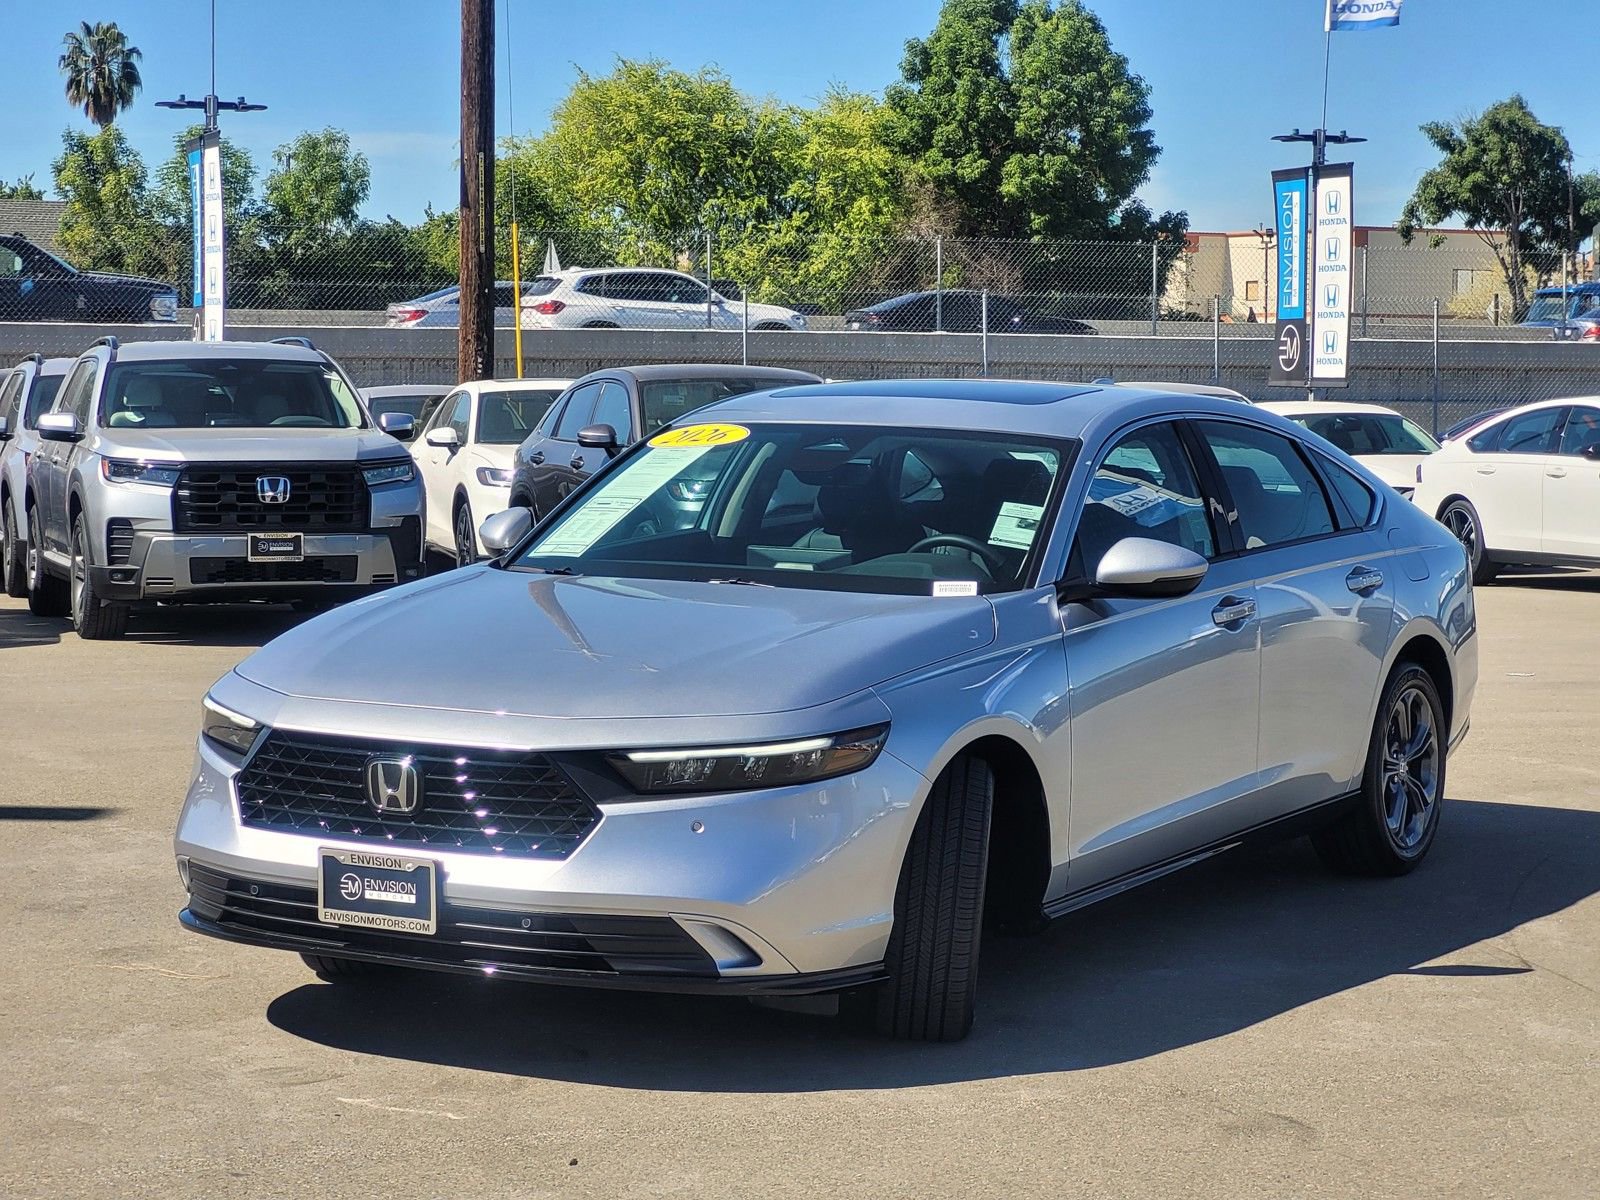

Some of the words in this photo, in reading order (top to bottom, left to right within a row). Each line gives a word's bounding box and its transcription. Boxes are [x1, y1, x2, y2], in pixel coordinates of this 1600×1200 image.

[1332, 1, 1397, 13] HONDA
[1319, 217, 1347, 226] HONDA
[1283, 192, 1293, 308] ENVISION
[1318, 264, 1347, 272] HONDA
[1317, 311, 1345, 319] HONDA
[350, 853, 402, 869] ENVISION
[364, 878, 416, 895] ENVISION
[324, 911, 430, 932] ENVISIONMOTORS.COM
